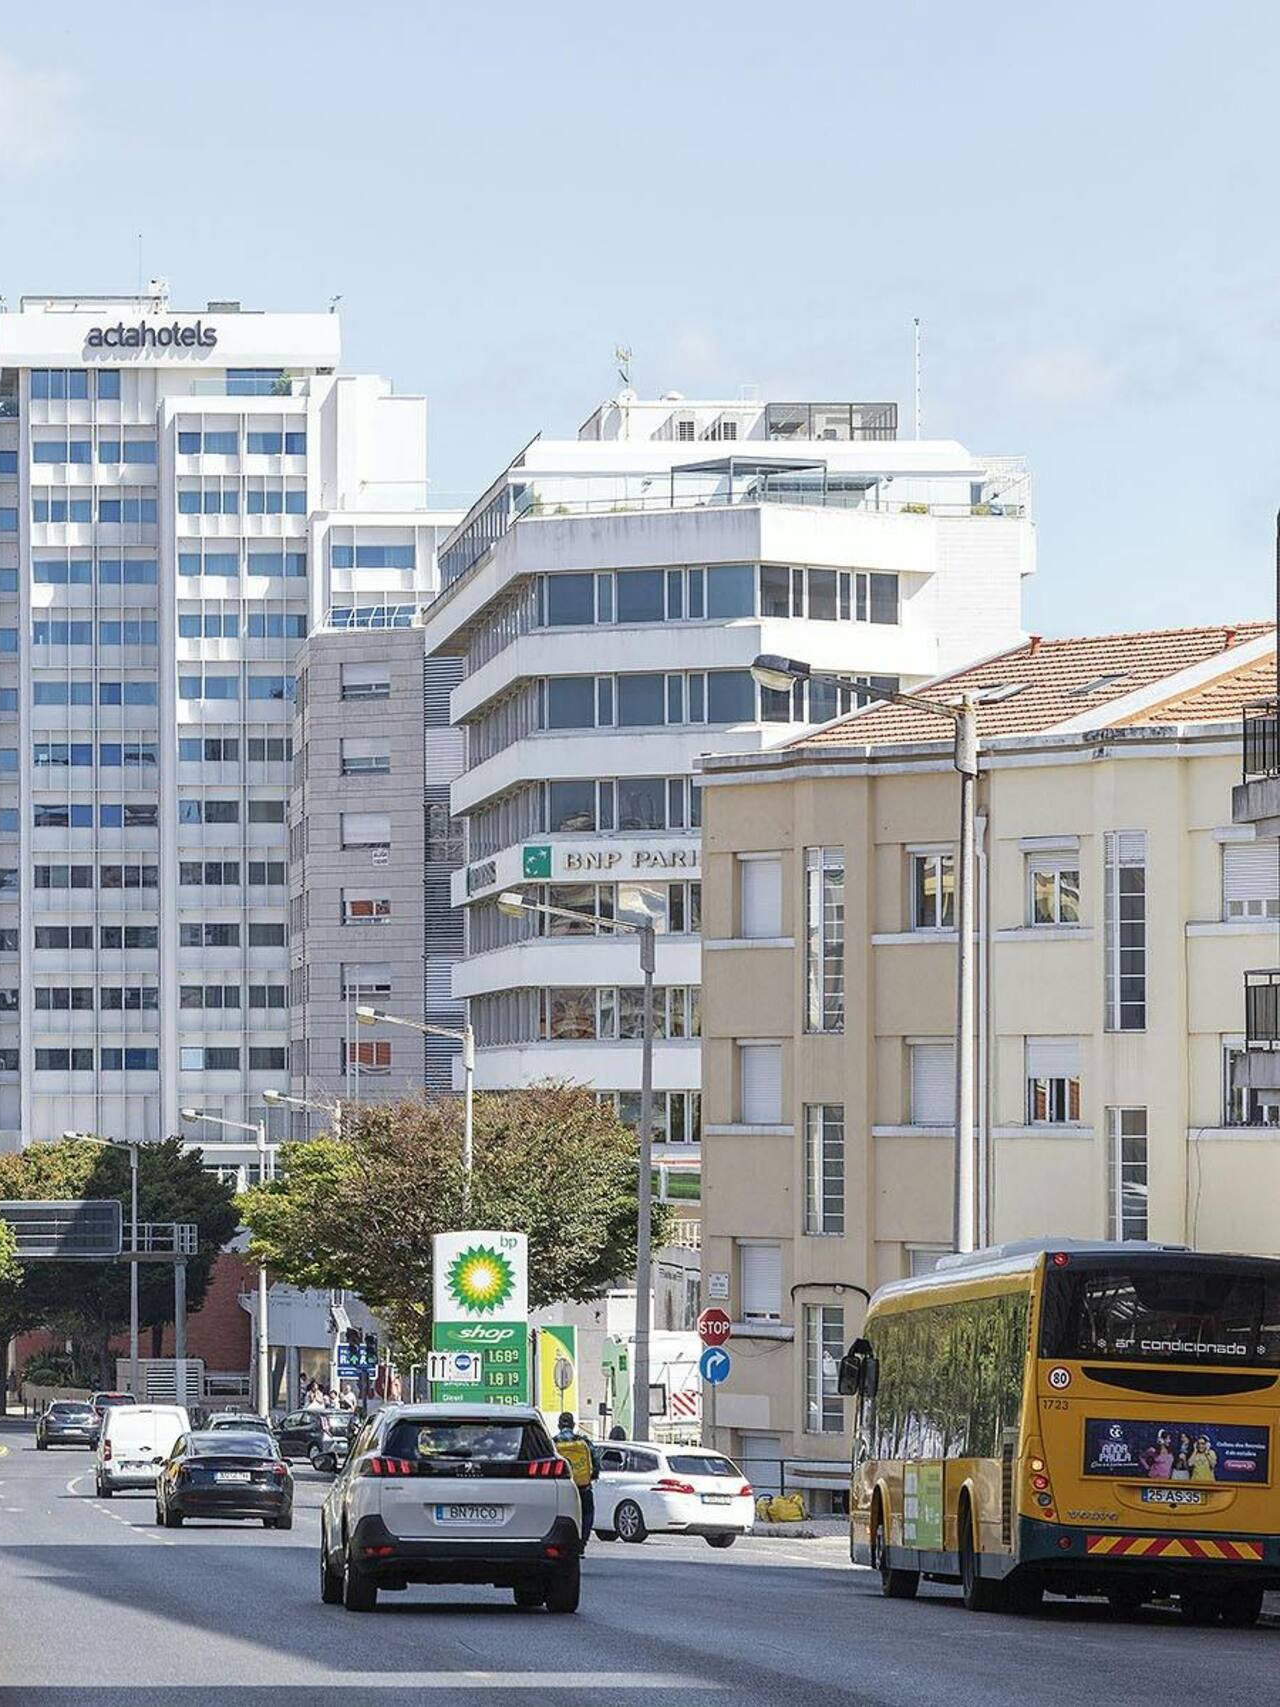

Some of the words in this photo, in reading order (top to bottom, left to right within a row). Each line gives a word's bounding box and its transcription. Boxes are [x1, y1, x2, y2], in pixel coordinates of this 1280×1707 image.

[87, 319, 218, 348] actahotels
[564, 852, 622, 870] BNP
[631, 849, 700, 869] PARI
[500, 1235, 518, 1250] bp
[456, 1324, 515, 1344] shop
[699, 1320, 730, 1335] STOP
[1115, 1338, 1136, 1349] ar
[1141, 1339, 1247, 1355] condicionado
[1052, 1371, 1068, 1386] 80
[1043, 1400, 1069, 1411] 1723
